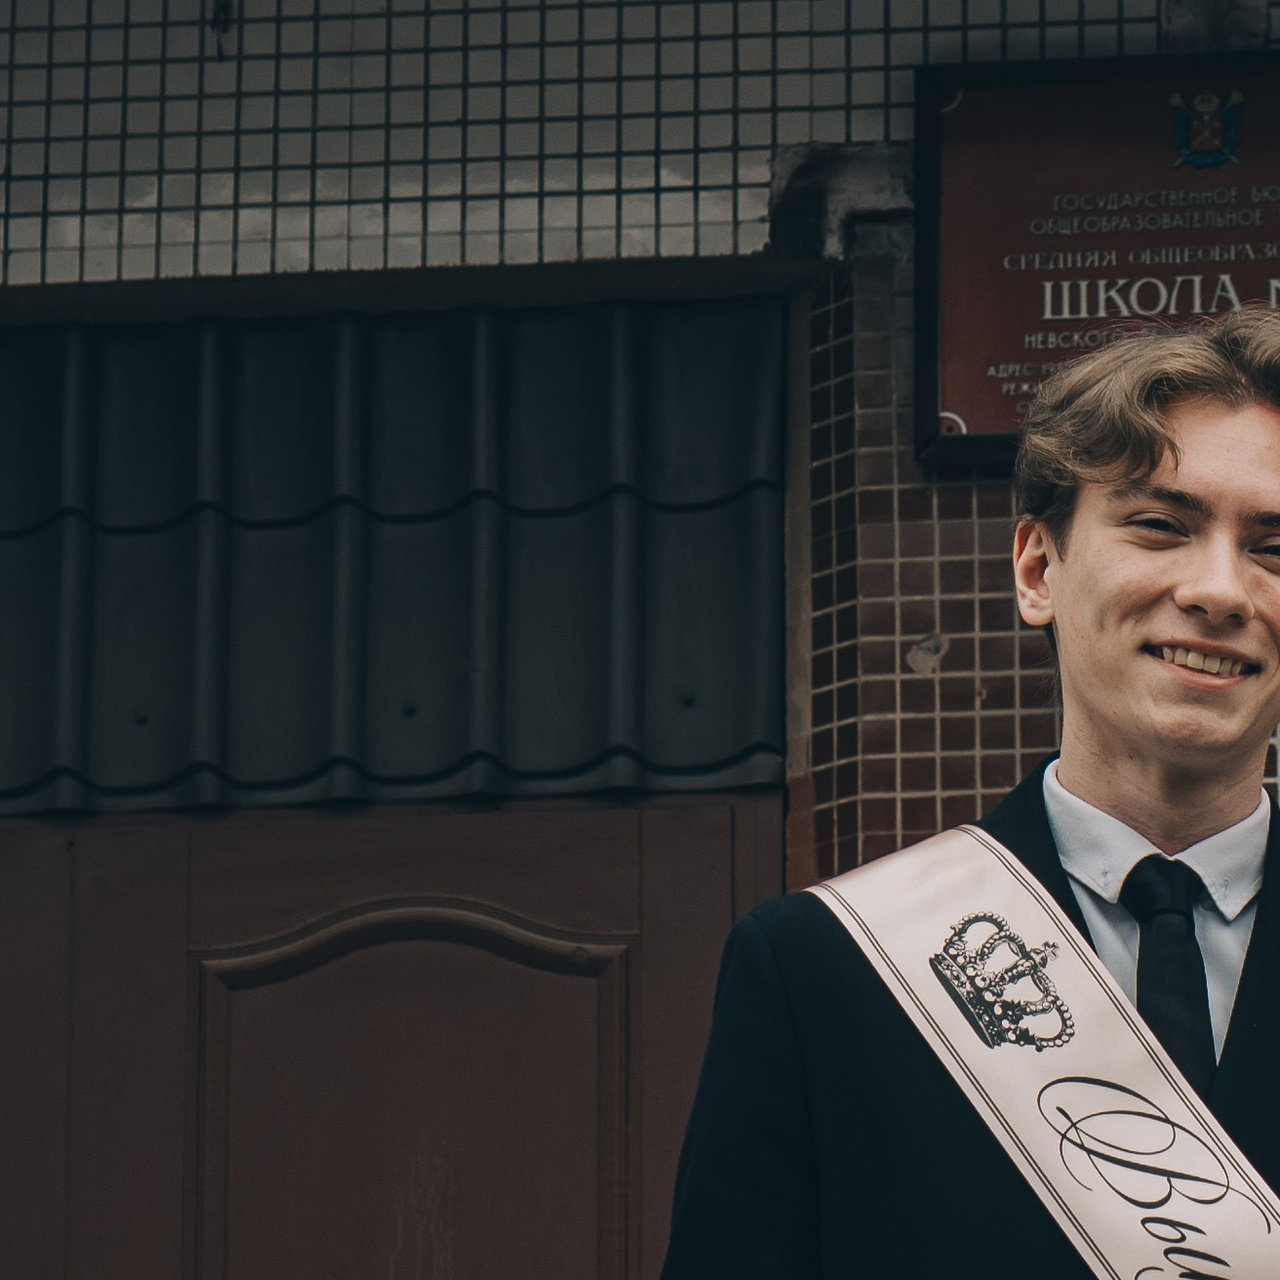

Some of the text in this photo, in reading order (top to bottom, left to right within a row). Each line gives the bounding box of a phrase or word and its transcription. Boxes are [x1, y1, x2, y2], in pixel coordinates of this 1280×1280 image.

[1053, 187, 1240, 211] ГОСУДАРСТВЕННОЕ
[1029, 208, 1264, 235] ОБЩЕОБРАЗОВАТЕЛЬНОЕ
[1003, 249, 1117, 270] СРЕДНЯЯ
[1041, 273, 1242, 320] ШКОЛА
